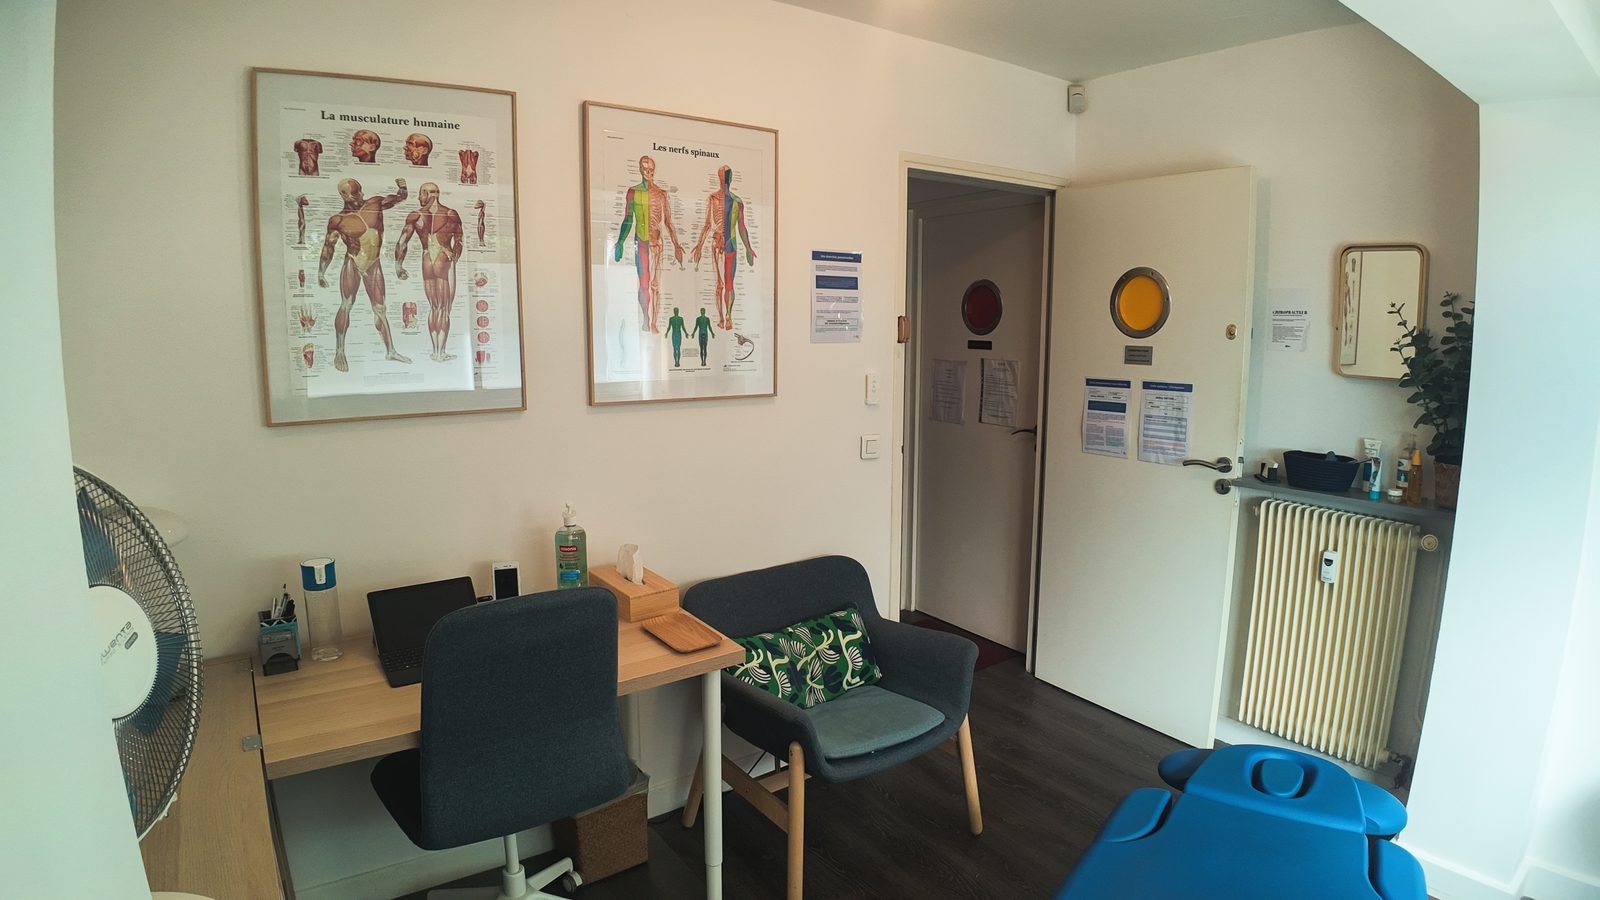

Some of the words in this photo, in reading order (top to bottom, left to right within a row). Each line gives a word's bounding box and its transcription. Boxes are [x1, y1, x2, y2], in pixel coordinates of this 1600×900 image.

[320, 110, 336, 121] La
[339, 114, 410, 126] musculature
[413, 117, 461, 130] humaine
[653, 142, 667, 152] Les
[668, 146, 689, 154] nerfs
[690, 148, 720, 159] spinaux
